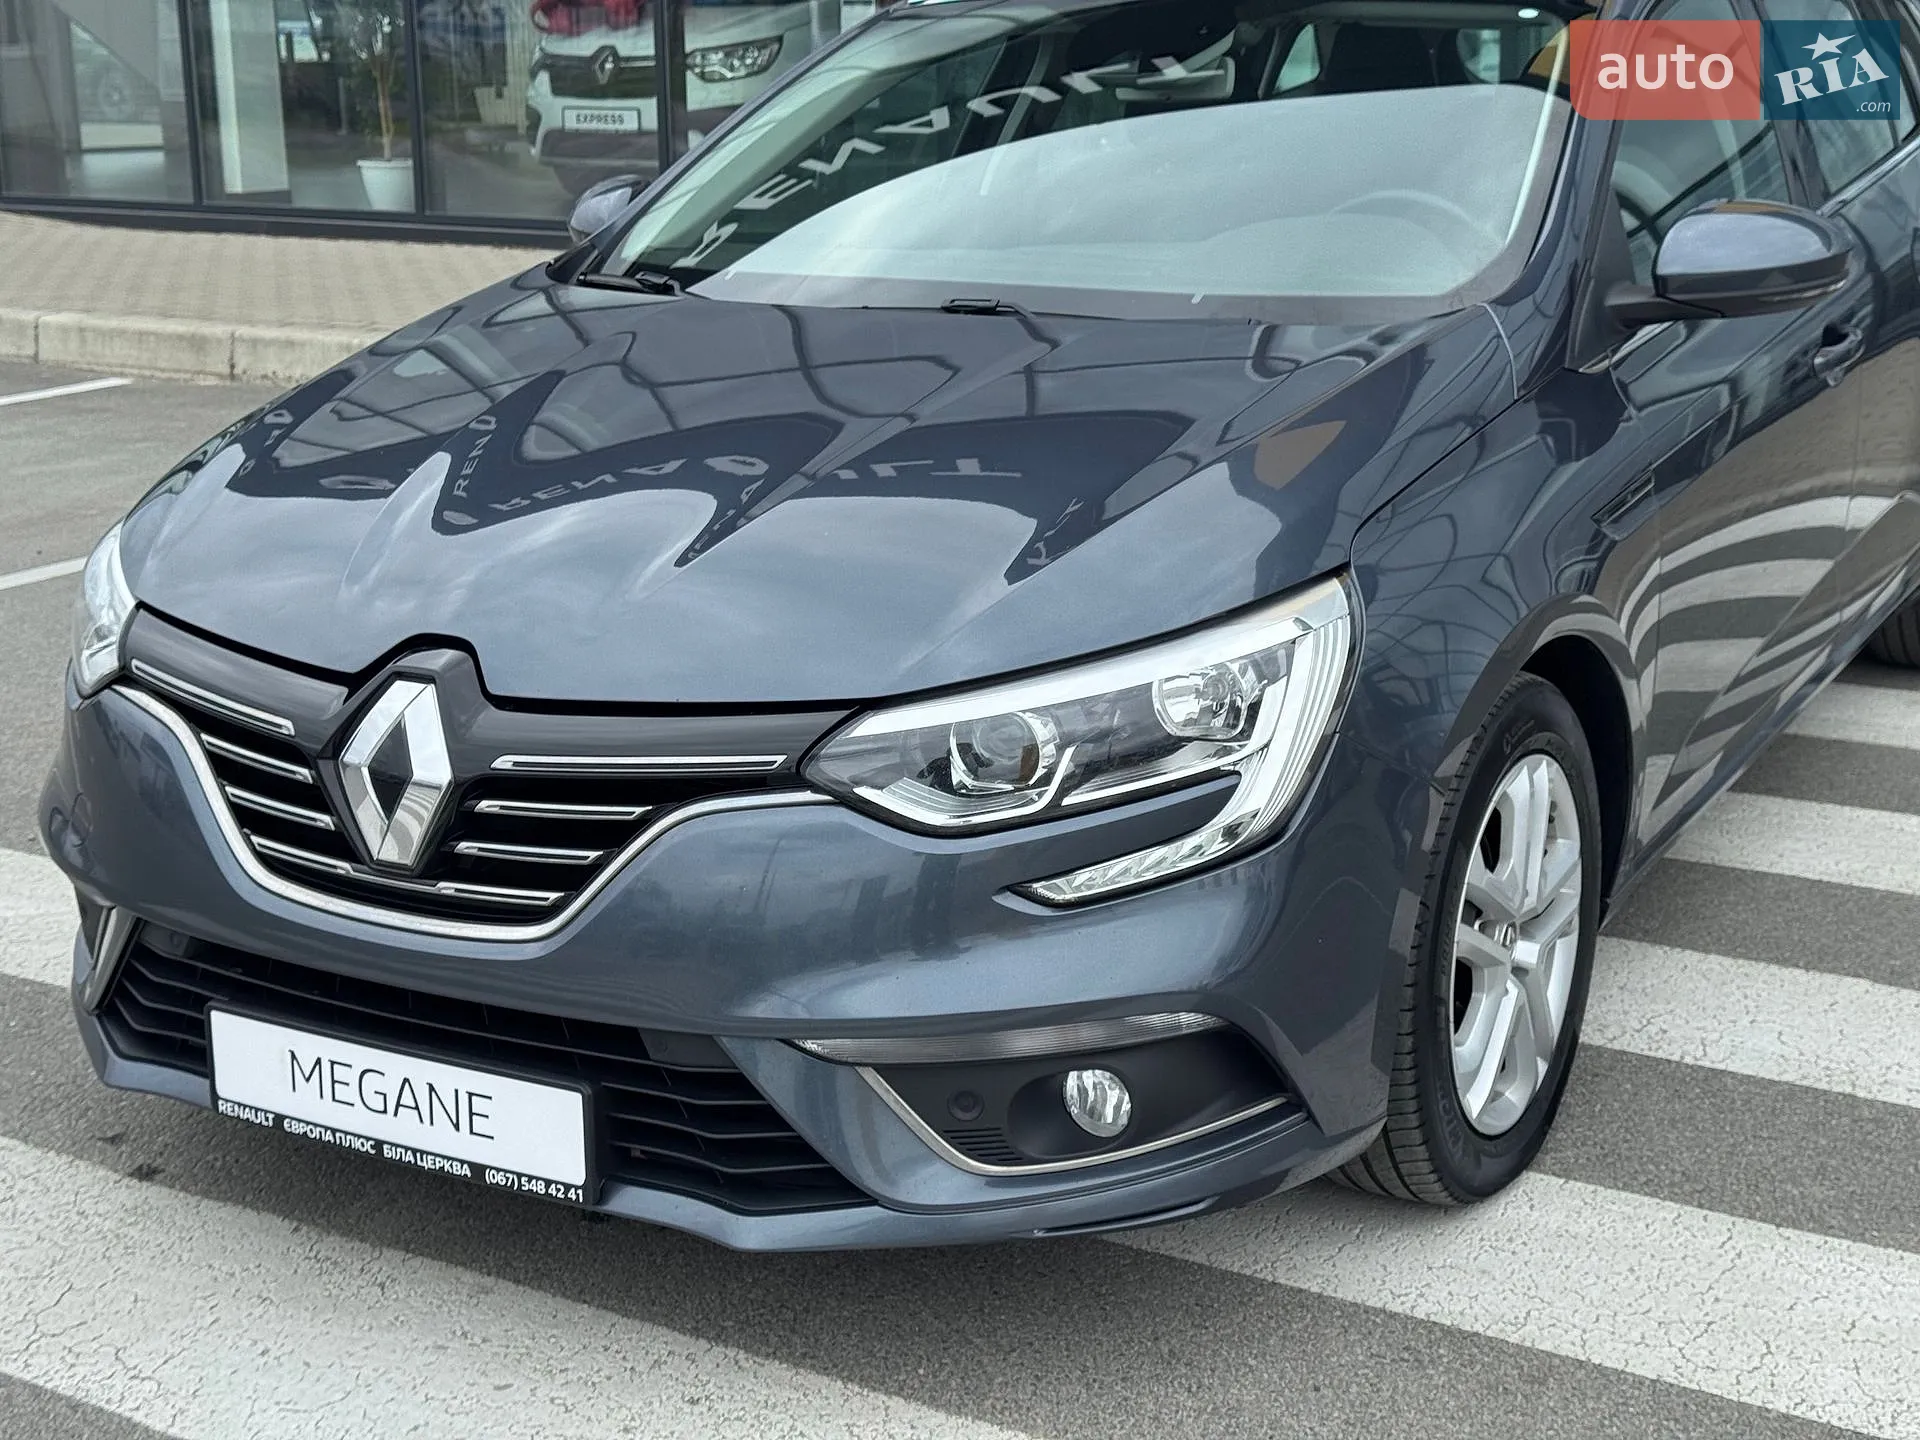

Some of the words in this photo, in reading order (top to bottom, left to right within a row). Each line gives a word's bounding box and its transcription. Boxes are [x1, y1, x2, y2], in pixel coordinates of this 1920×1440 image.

[576, 113, 625, 125] EXPRESS
[288, 1049, 495, 1141] MEGANE
[217, 1100, 275, 1128] RENAULT
[283, 1118, 335, 1144] ЄВРОПА
[335, 1132, 377, 1155] ПЛЮС
[382, 1144, 415, 1165] БІЛА
[416, 1152, 471, 1178] ЦЕРКВА
[485, 1167, 518, 1191] (067)
[520, 1176, 546, 1195] 548
[547, 1185, 565, 1199] 42
[567, 1186, 584, 1203] 41
